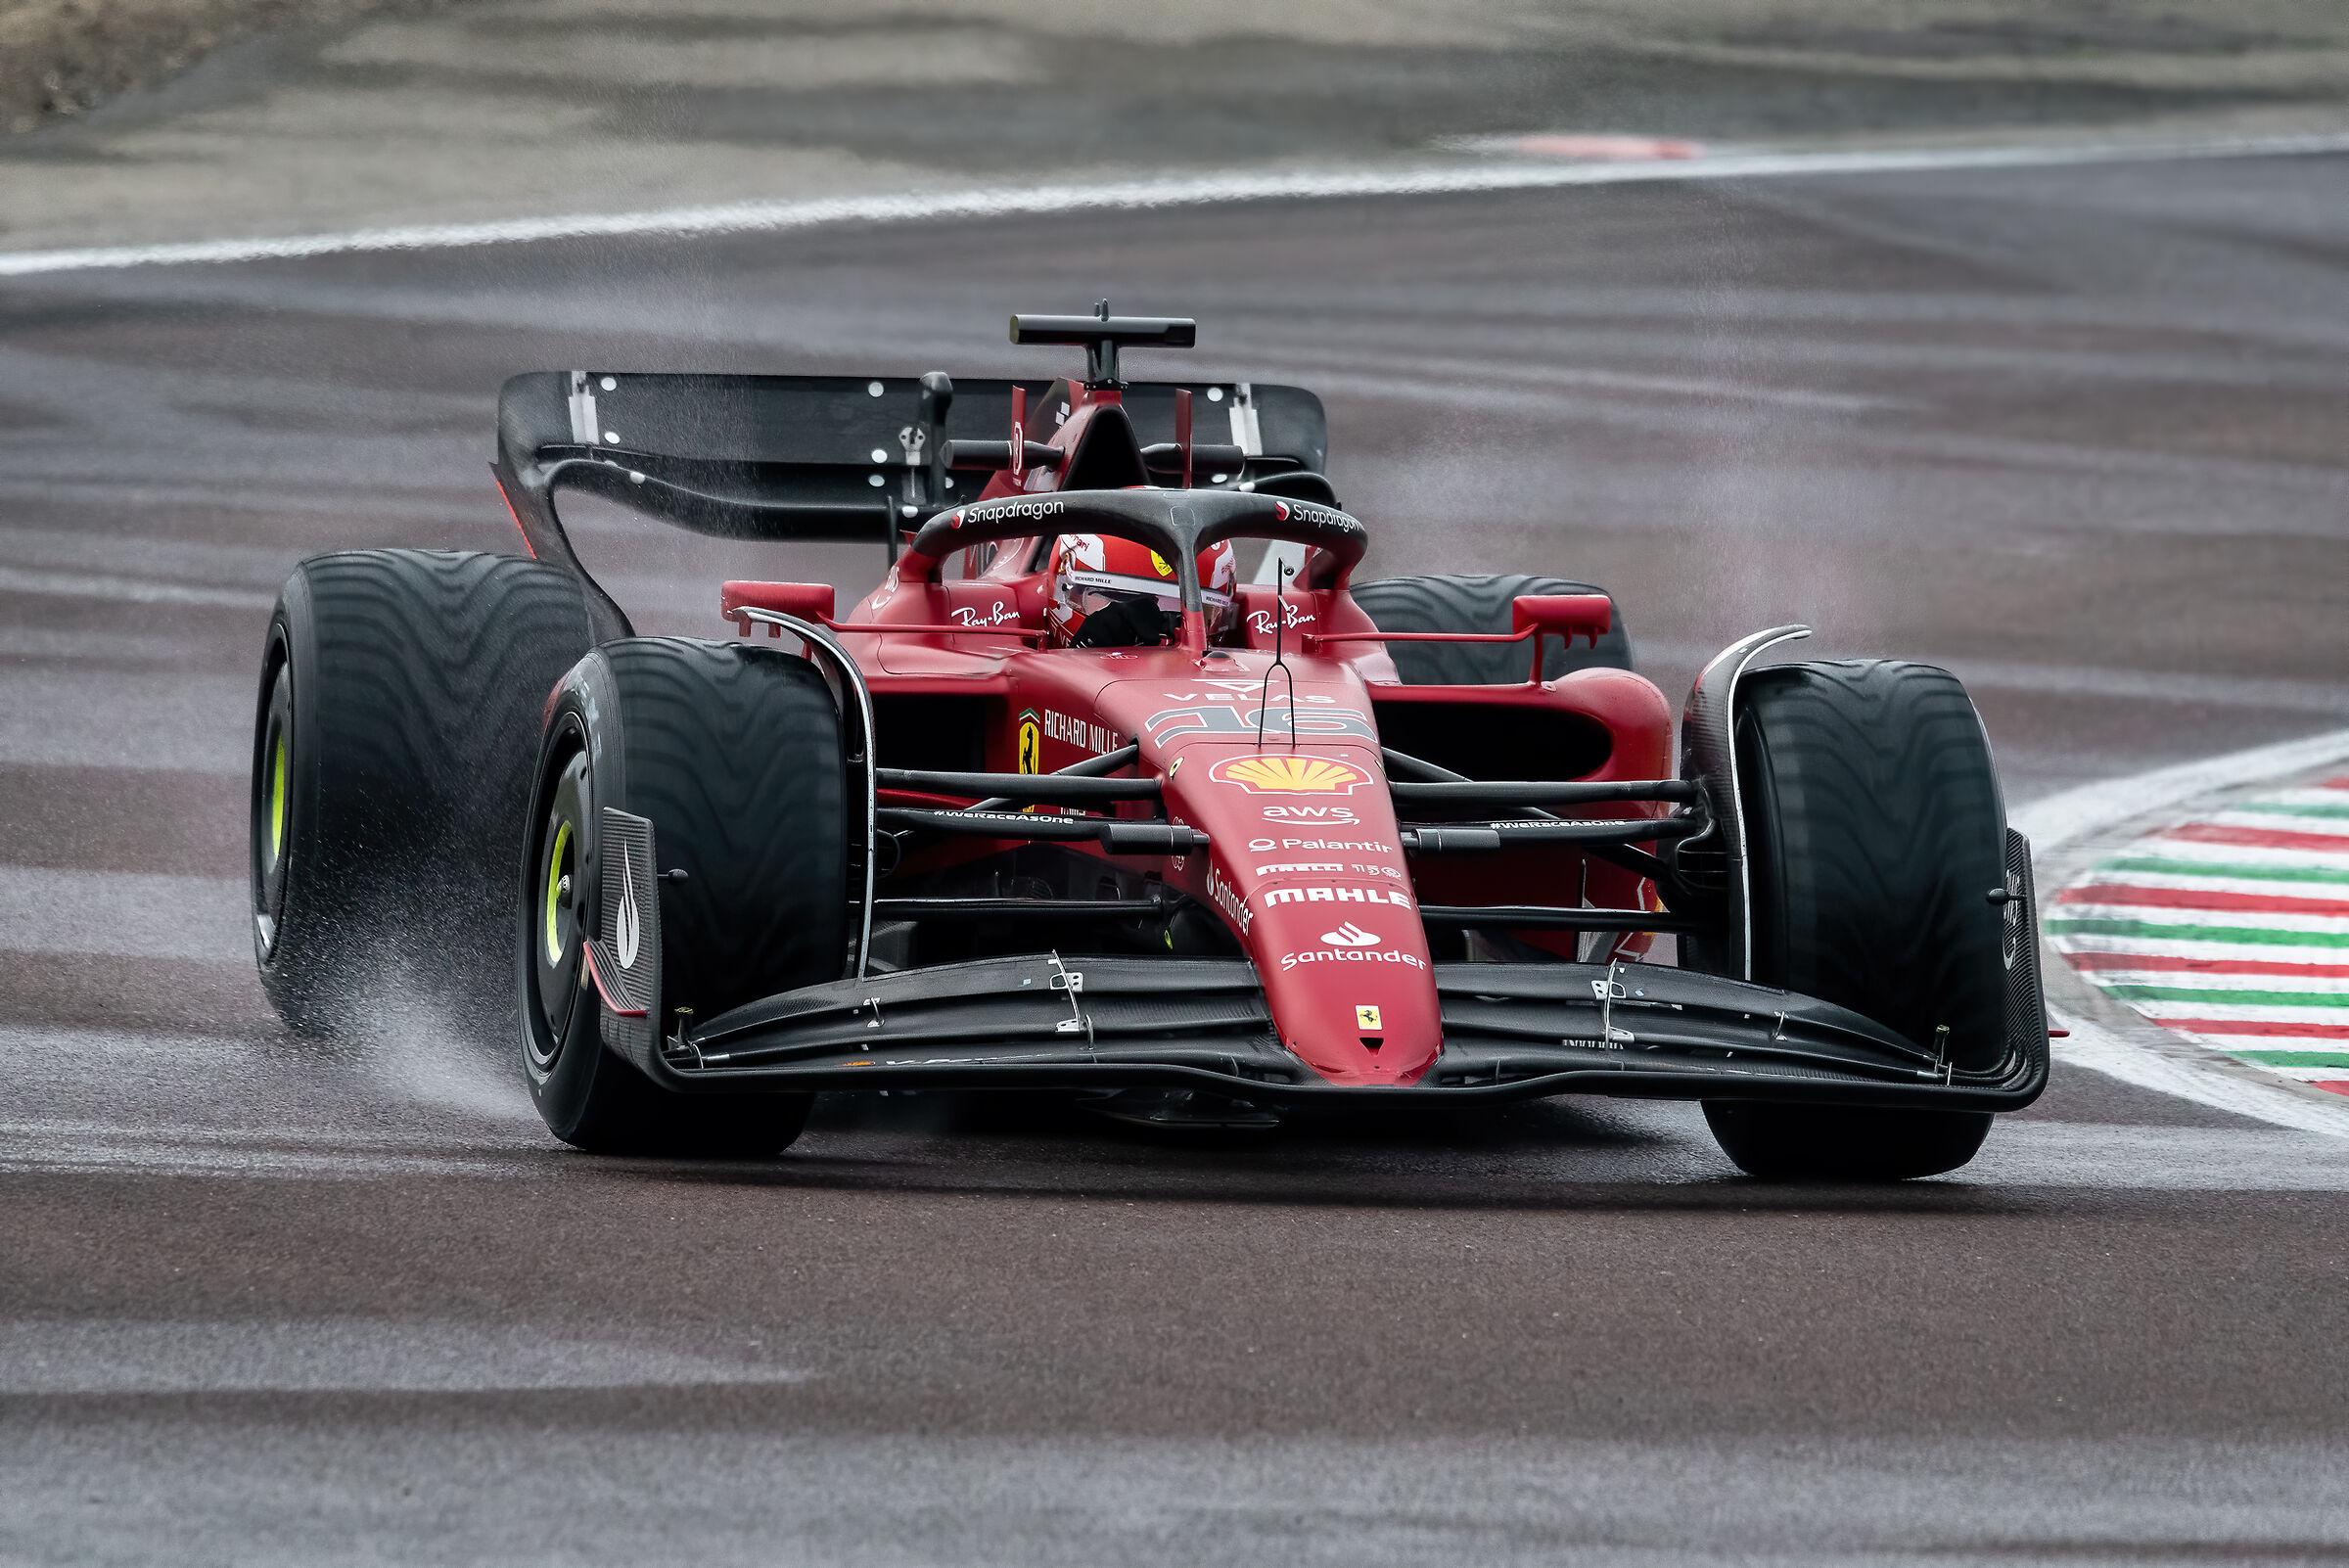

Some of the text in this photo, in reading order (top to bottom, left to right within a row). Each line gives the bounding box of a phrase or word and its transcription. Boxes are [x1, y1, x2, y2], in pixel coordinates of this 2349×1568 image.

[967, 501, 1064, 524] Snapdragon
[1293, 504, 1359, 532] Snapdragon
[950, 601, 1021, 627] Ray-Ban
[1164, 692, 1337, 704] VELAS
[1044, 709, 1119, 756] RICHARD MILLE
[1144, 706, 1378, 750] 16
[933, 809, 1075, 824] #WeRaceAsOne
[1262, 806, 1355, 818] aws
[1490, 820, 1626, 830] #WeRaceAsOne
[1281, 838, 1393, 853] Palantir
[1214, 868, 1254, 937] Santander
[1264, 887, 1412, 910] MAHLE
[1280, 947, 1427, 972] Santander
